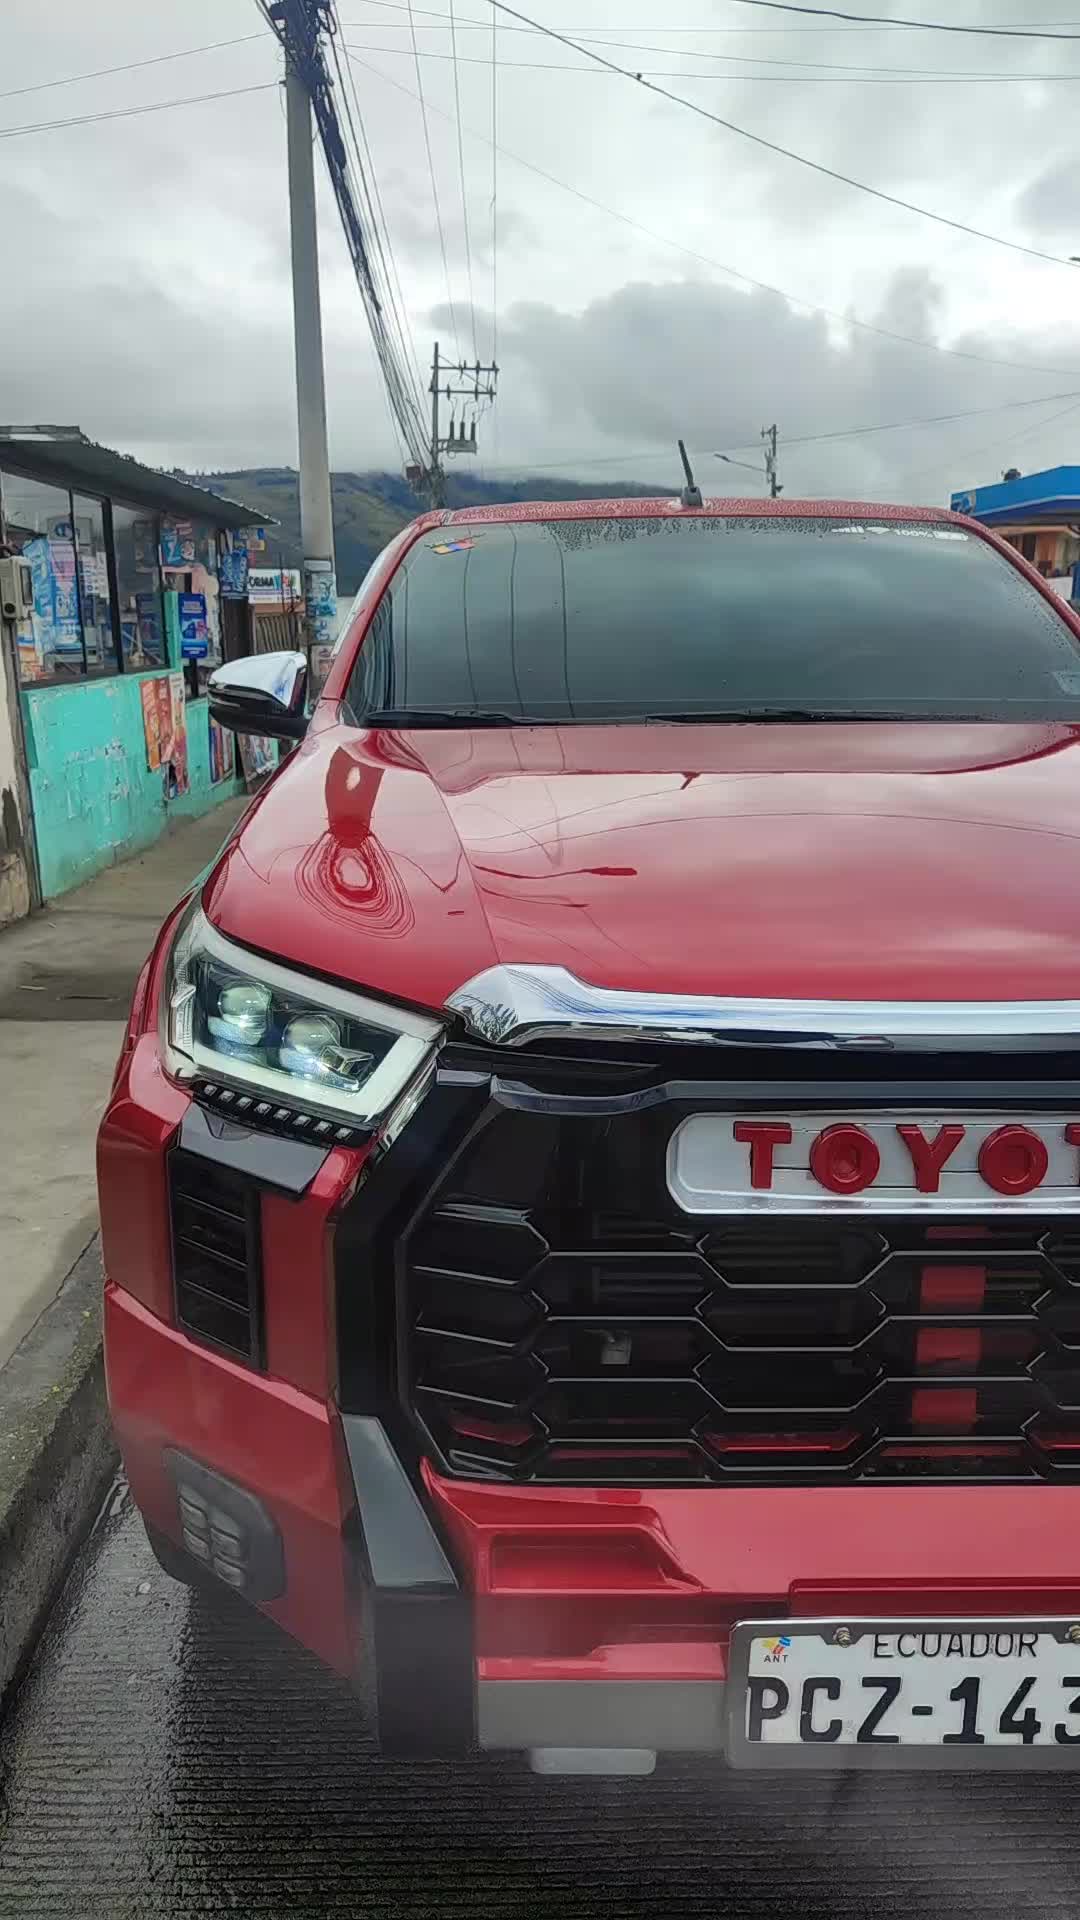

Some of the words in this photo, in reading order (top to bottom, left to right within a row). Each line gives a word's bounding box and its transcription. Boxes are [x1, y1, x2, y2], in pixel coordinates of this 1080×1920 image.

[733, 1121, 1080, 1195] TOYO
[873, 1633, 1039, 1658] ECUADOR
[764, 1655, 789, 1663] ANT
